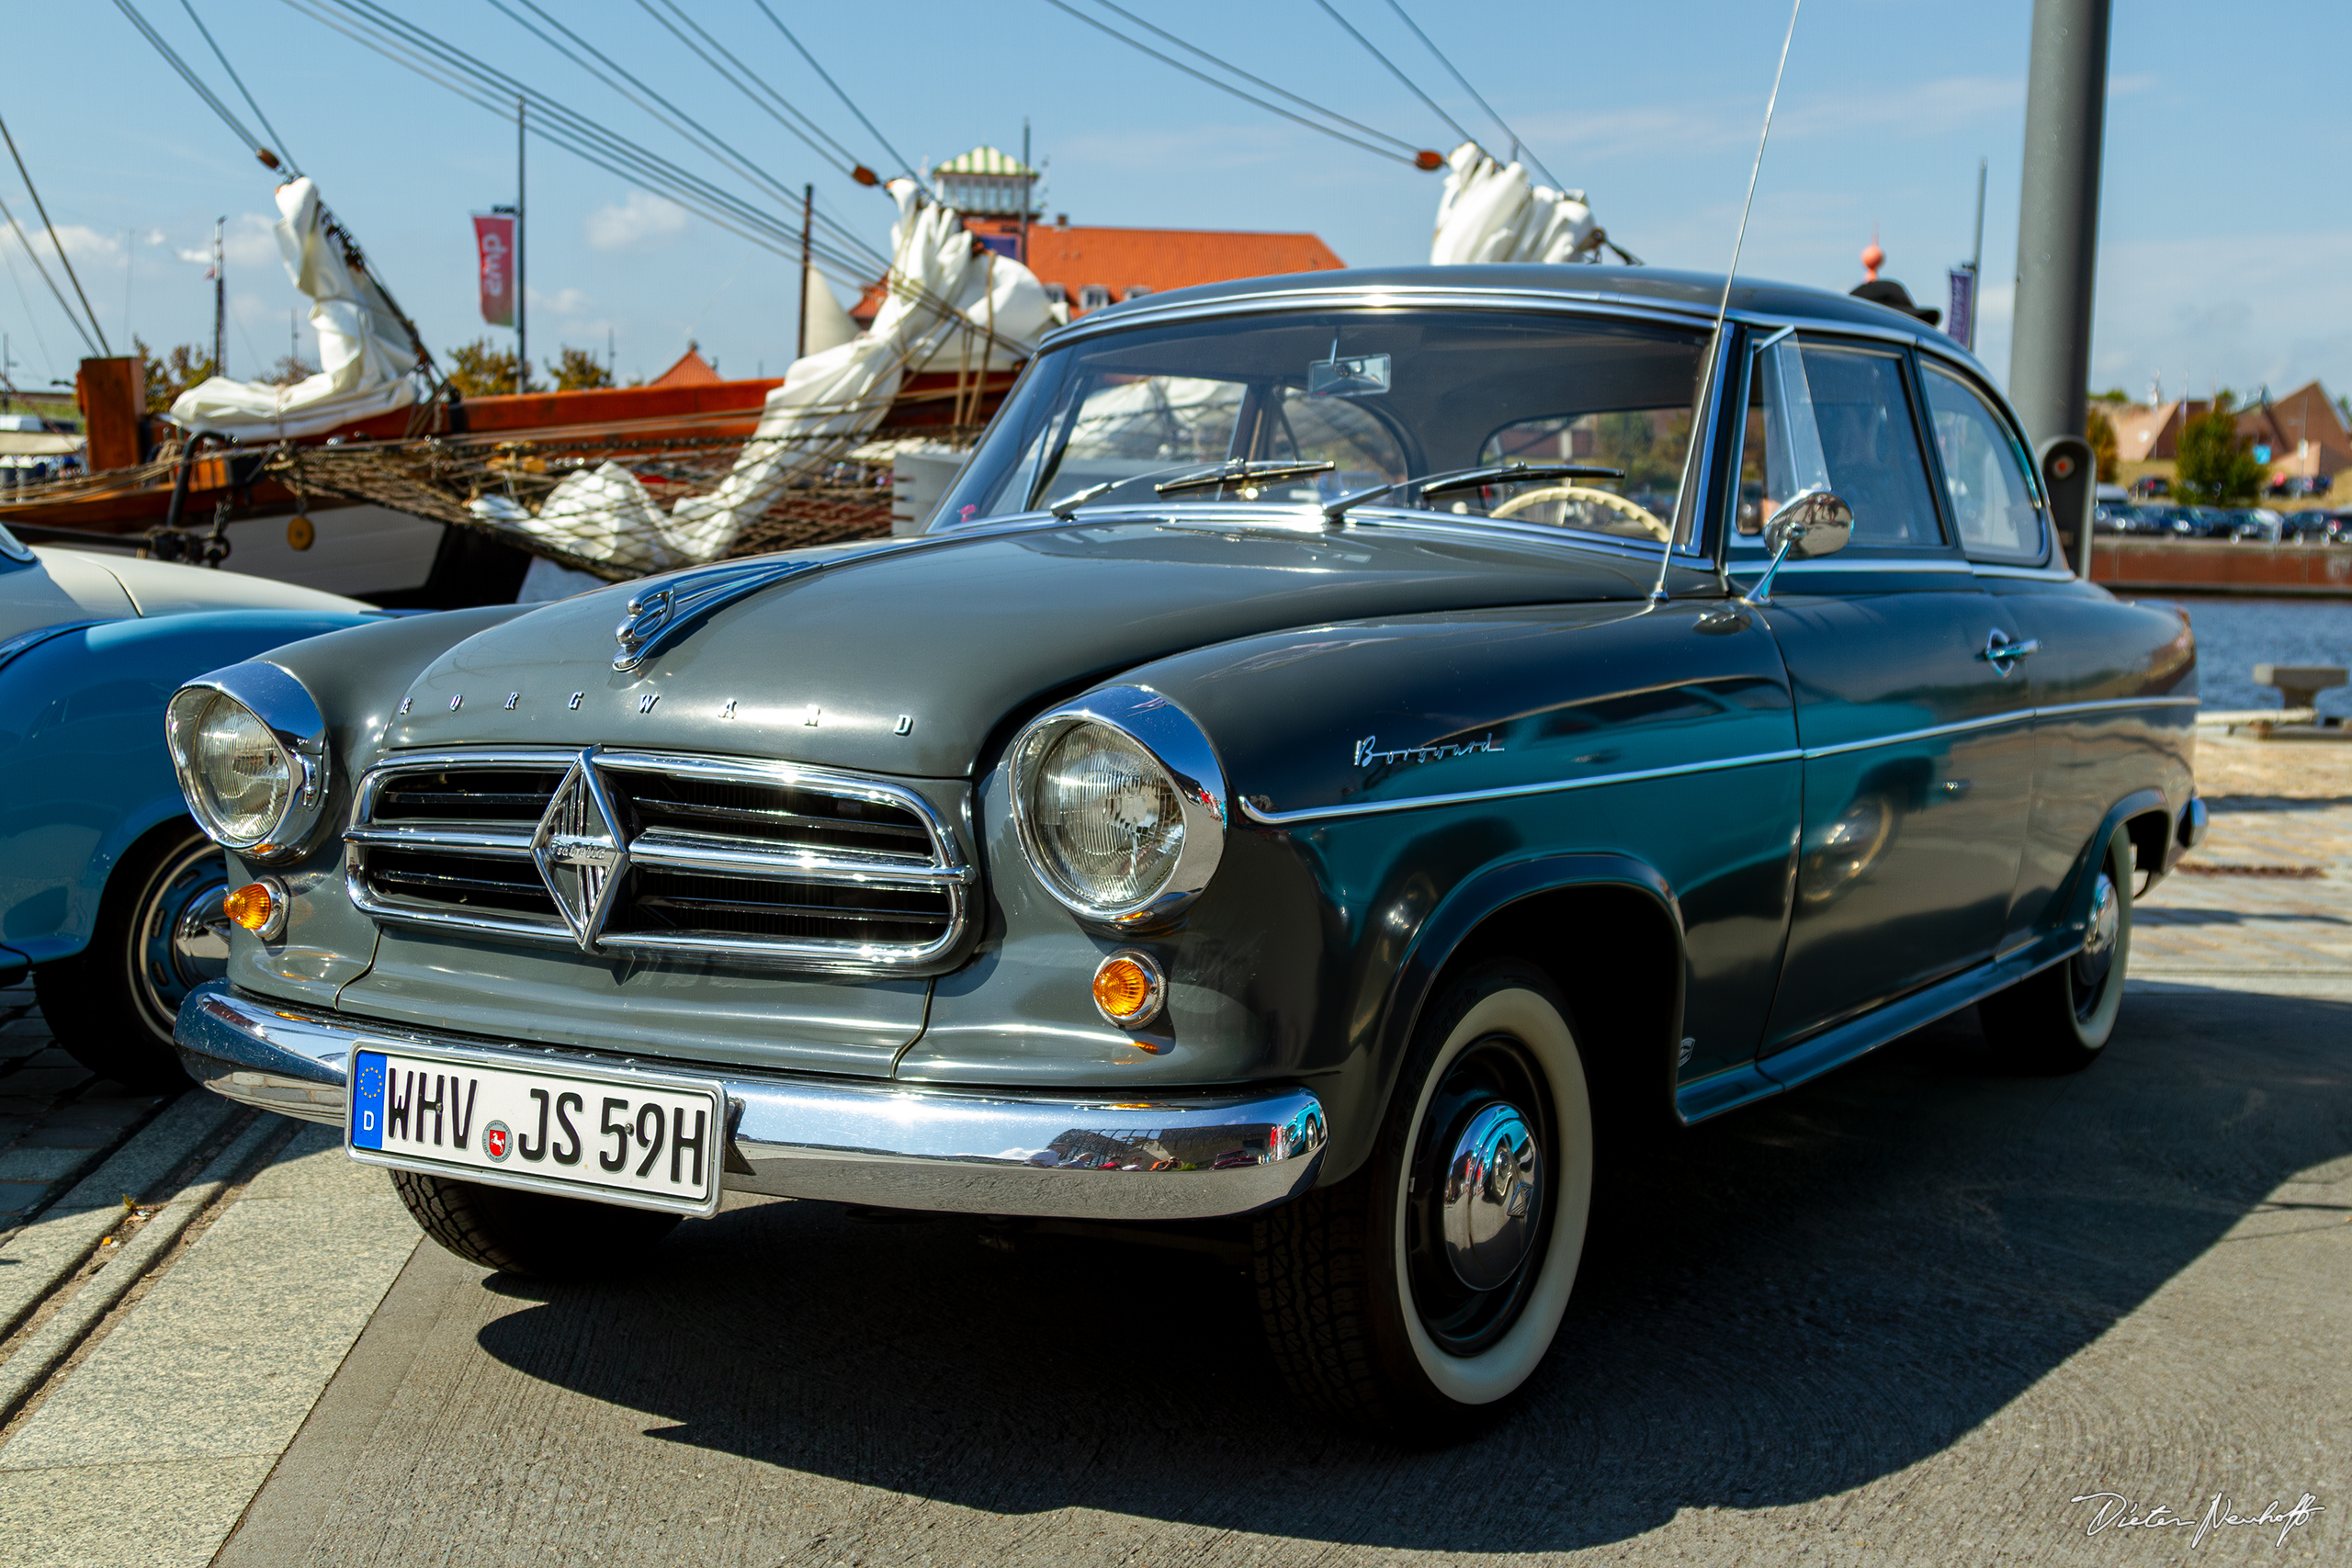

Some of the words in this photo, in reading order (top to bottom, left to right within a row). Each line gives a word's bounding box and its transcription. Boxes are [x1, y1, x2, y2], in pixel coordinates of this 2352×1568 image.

[1353, 732, 1505, 768] Borgward
[363, 1110, 374, 1131] D
[388, 1067, 478, 1150] WHV
[518, 1088, 583, 1166] JS
[599, 1097, 707, 1186] 59H
